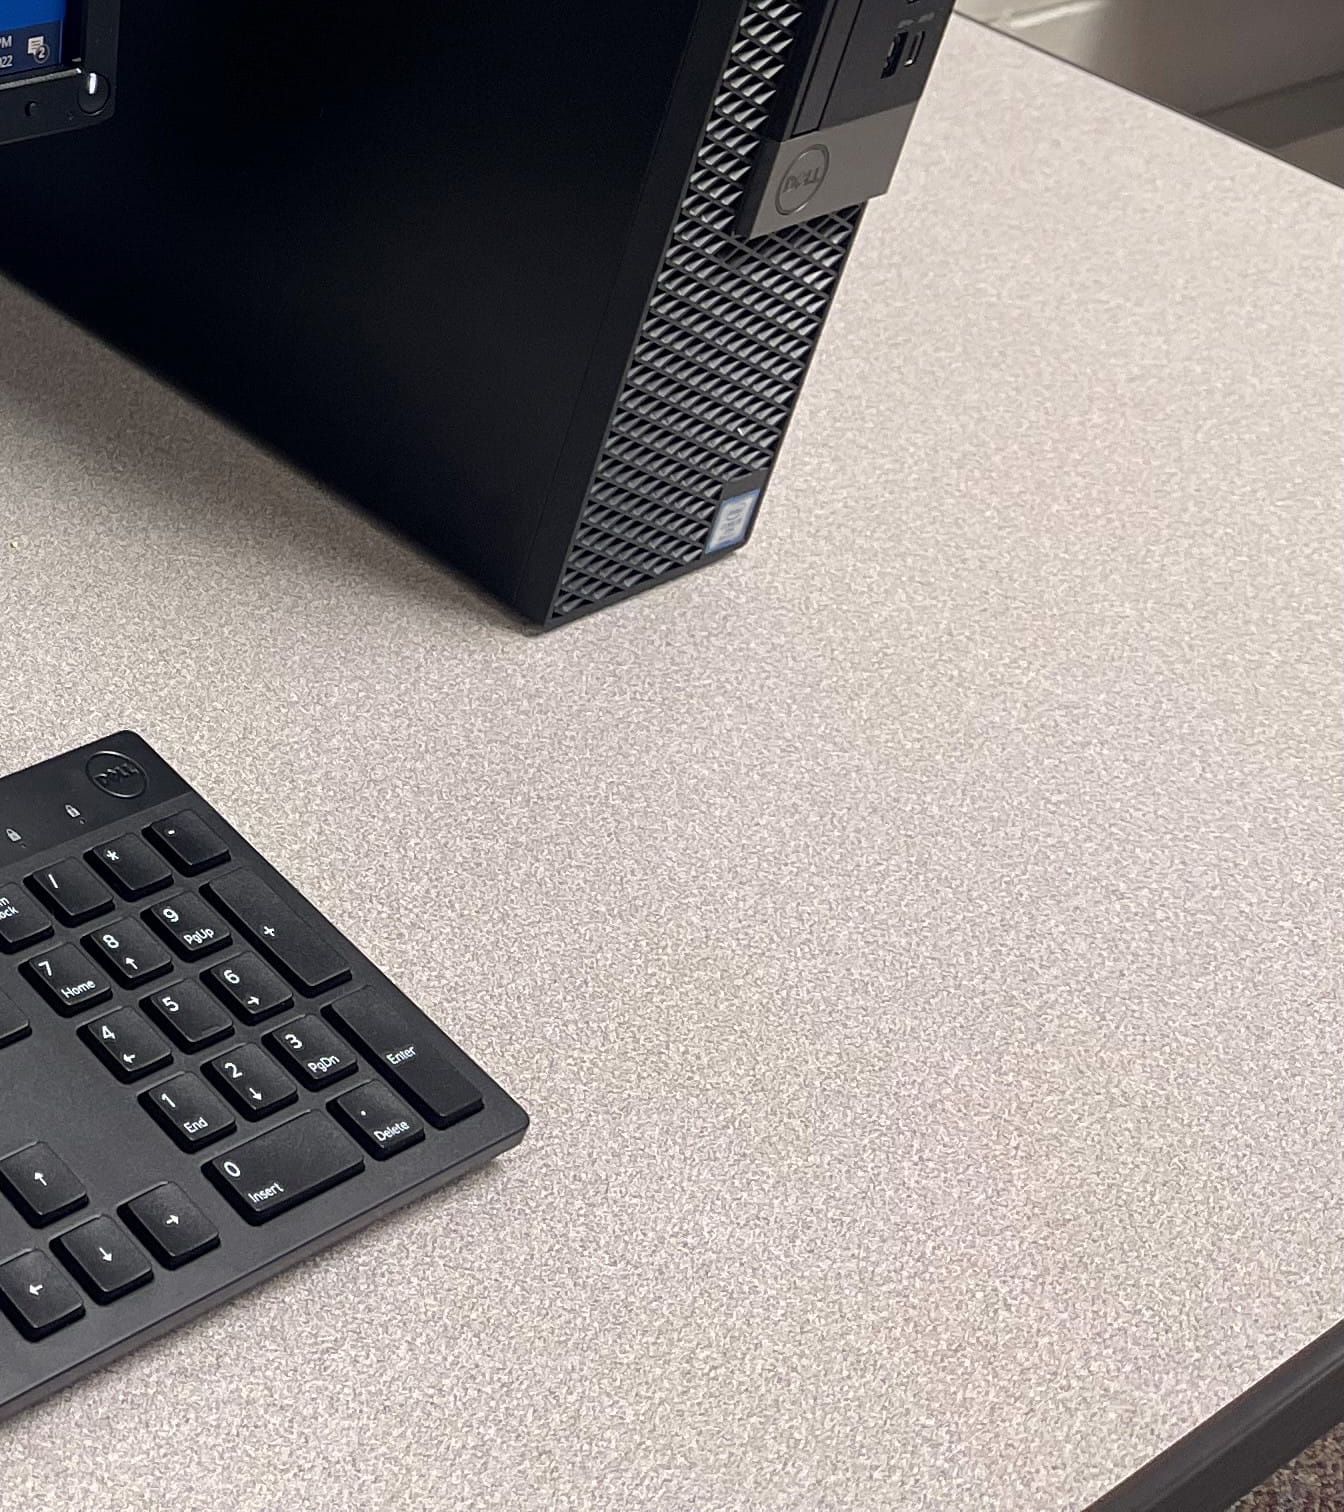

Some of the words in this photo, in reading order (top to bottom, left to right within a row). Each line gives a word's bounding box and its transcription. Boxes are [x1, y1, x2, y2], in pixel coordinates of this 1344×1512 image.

[163, 908, 180, 923] 9
[103, 934, 120, 950] 8
[184, 927, 215, 947] PgUp
[38, 961, 54, 977] 7
[224, 969, 241, 986] 6
[61, 978, 96, 1000] Home
[162, 996, 181, 1013] 5
[101, 1025, 116, 1042] 4
[285, 1034, 303, 1050] 3
[386, 1045, 418, 1066] Enter
[225, 1062, 244, 1080] 2
[308, 1053, 341, 1076] PgDn
[162, 1093, 177, 1109] 1
[184, 1117, 209, 1135] End
[374, 1119, 410, 1143] Delete
[248, 1182, 285, 1205] Insert
